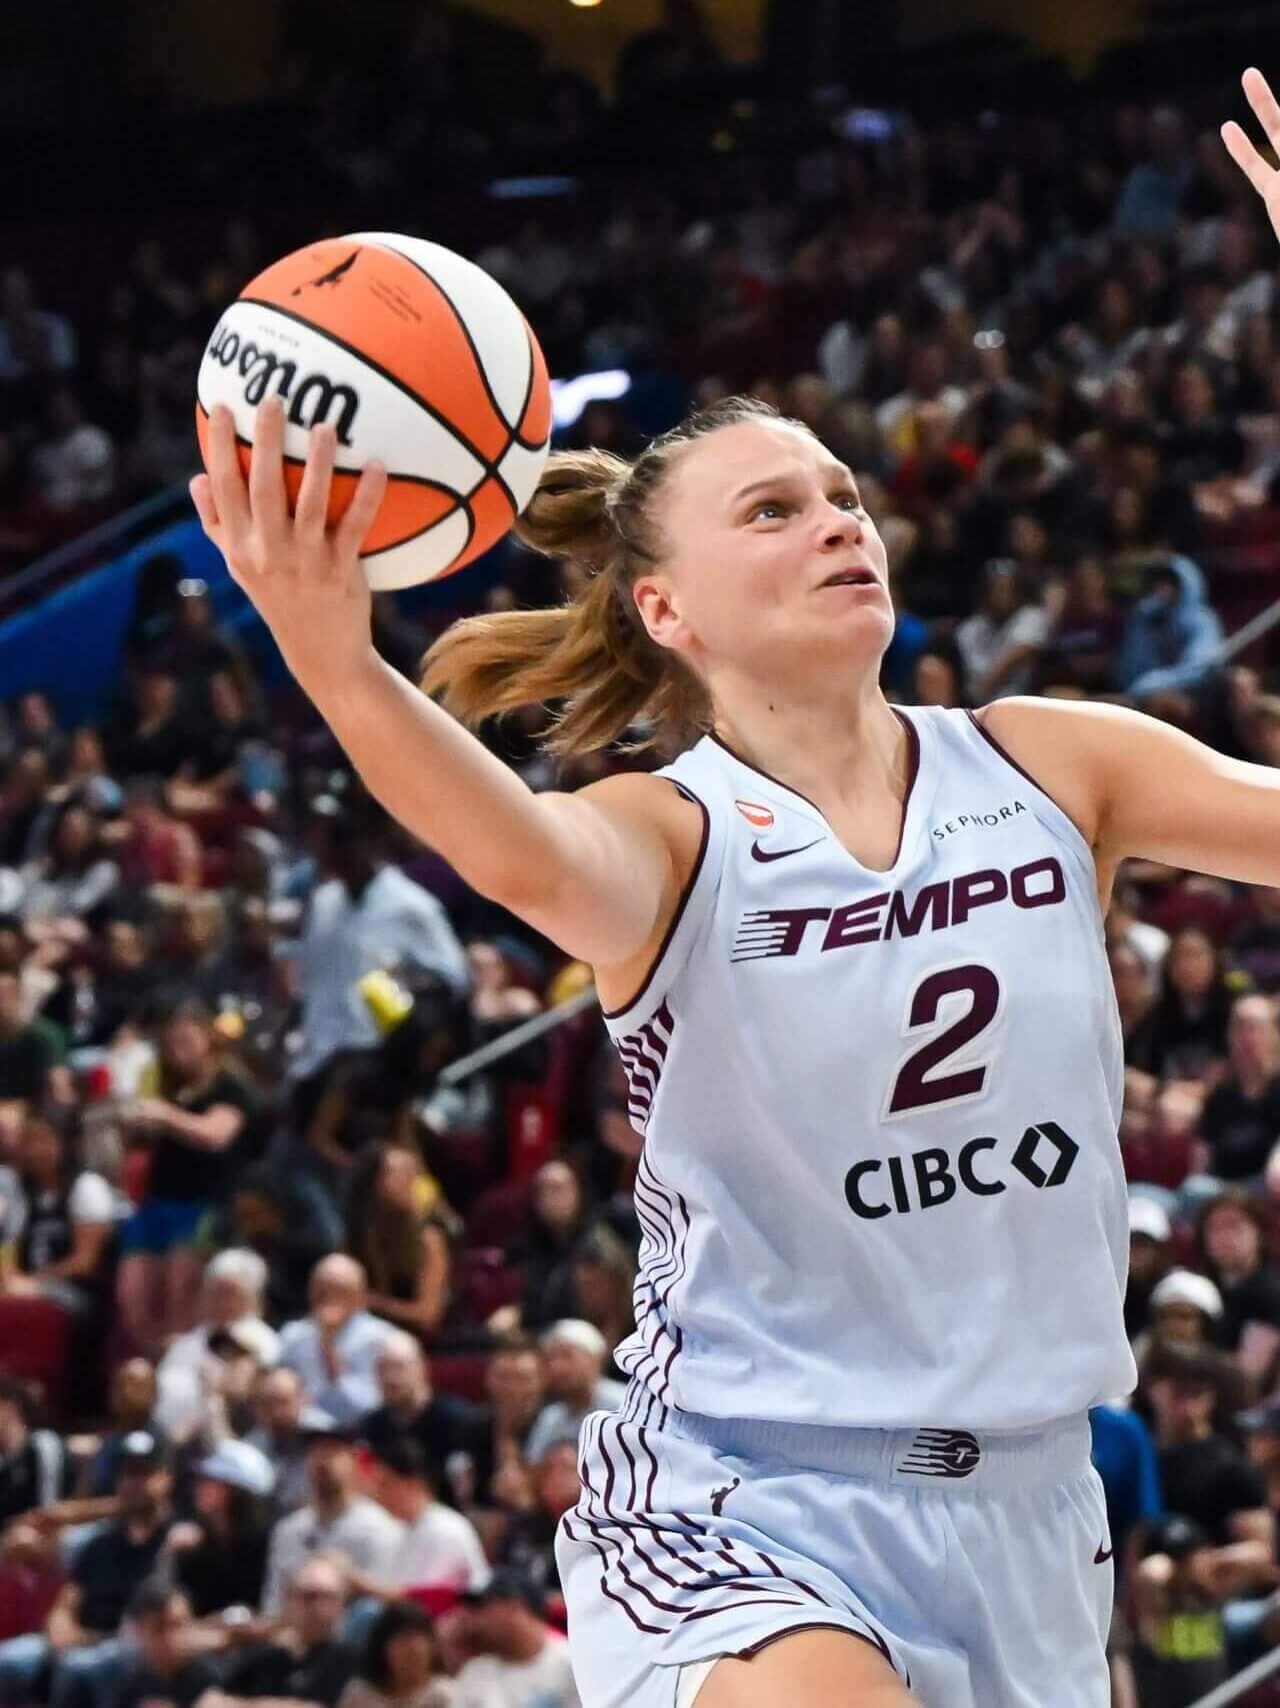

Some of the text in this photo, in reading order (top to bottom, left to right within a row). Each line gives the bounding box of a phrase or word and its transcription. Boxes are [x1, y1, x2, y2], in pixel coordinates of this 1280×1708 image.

[932, 800, 1028, 841] SEPHORA
[731, 857, 1067, 963] TEMPO
[889, 965, 1000, 1113] 2
[844, 1137, 1007, 1220] CIBC
